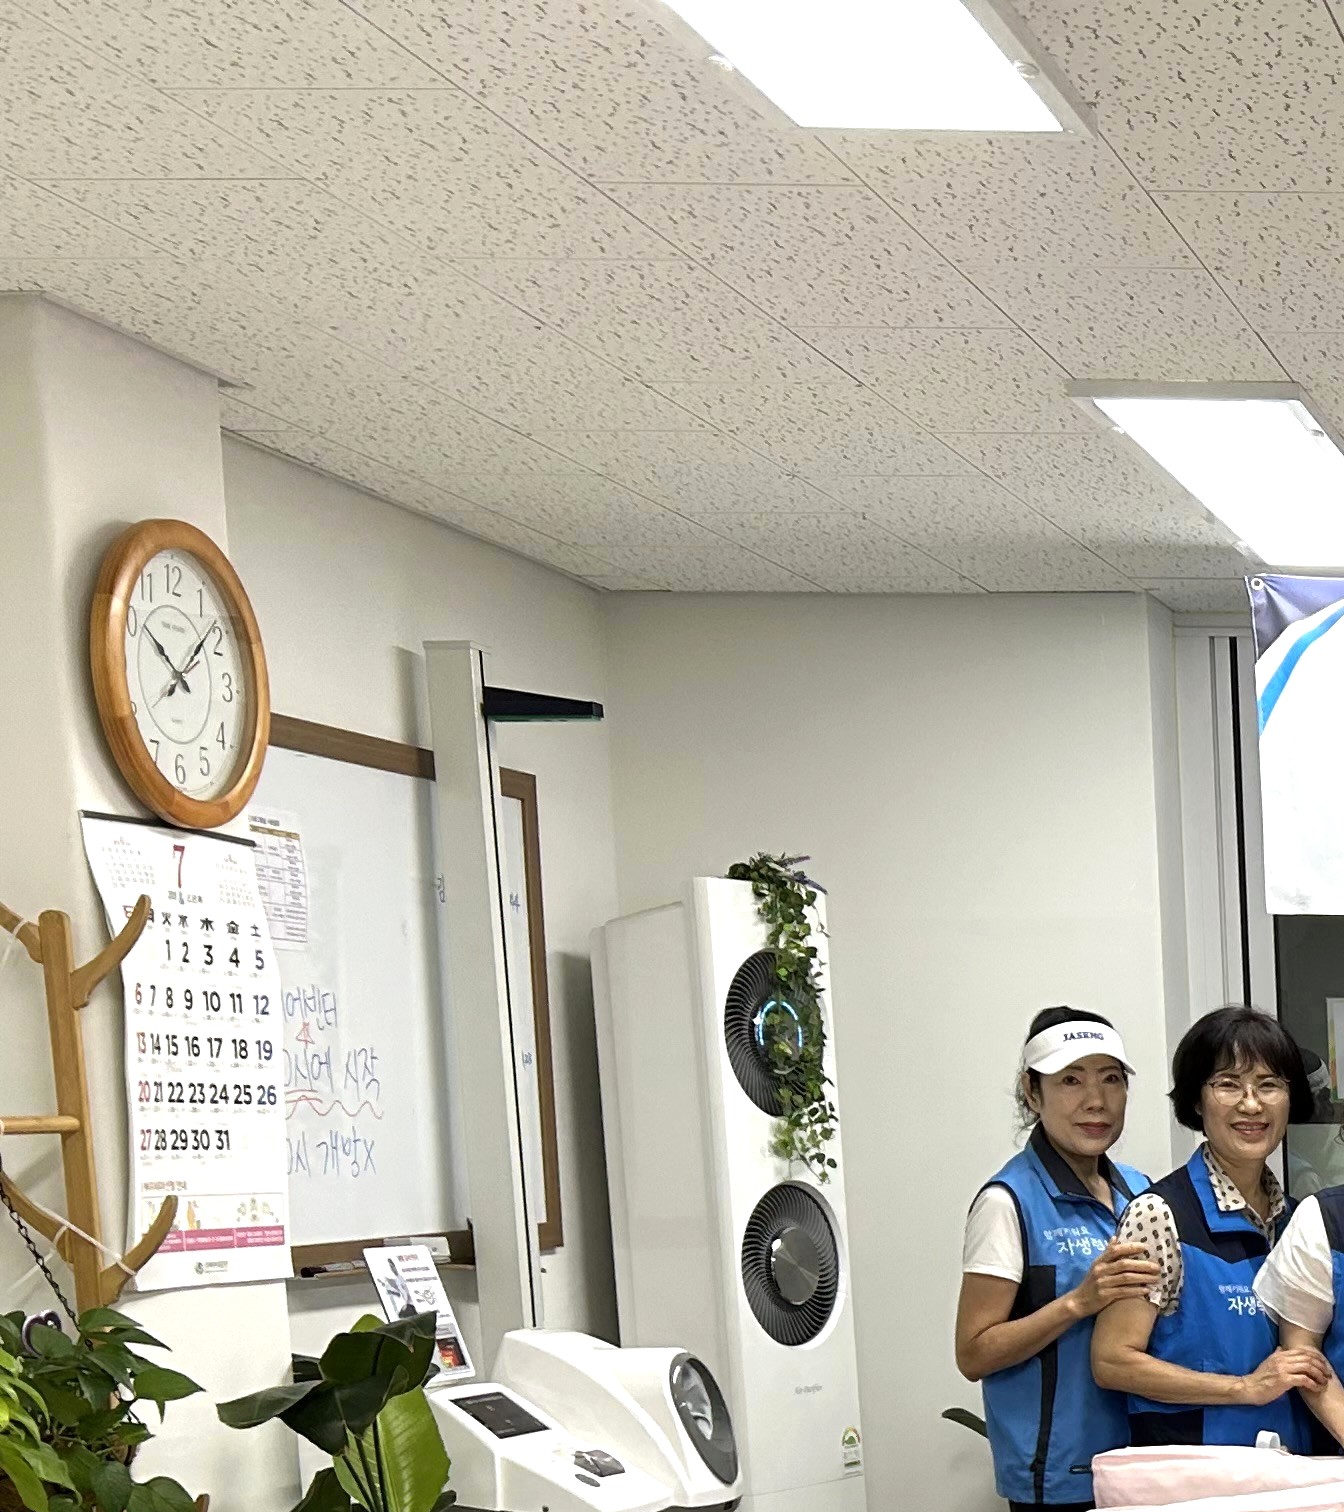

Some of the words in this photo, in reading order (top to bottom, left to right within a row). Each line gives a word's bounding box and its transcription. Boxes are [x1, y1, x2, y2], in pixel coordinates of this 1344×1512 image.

[164, 564, 182, 597] 12
[197, 588, 203, 618] 1
[212, 625, 223, 657] 2
[222, 672, 233, 703] 3
[175, 753, 186, 785] 6
[199, 746, 211, 777] 5
[216, 721, 226, 750] 4
[173, 844, 185, 889] 7
[165, 940, 171, 961] 1
[182, 942, 190, 963] 2
[203, 944, 214, 965] 3
[229, 947, 240, 968] 4
[255, 950, 264, 970] 5
[135, 982, 142, 1005] 6
[150, 985, 156, 1006] 7
[166, 987, 173, 1008] 8
[184, 989, 193, 1010] 9
[202, 990, 221, 1012] 10
[229, 992, 243, 1014] 11
[253, 995, 270, 1015] 12
[136, 1032, 146, 1054] 13
[150, 1033, 161, 1055] 14
[165, 1034, 179, 1056] 15
[185, 1036, 200, 1057] 16
[207, 1037, 223, 1058] 17
[231, 1039, 248, 1059] 18
[255, 1040, 273, 1061] 19
[138, 1080, 150, 1102] 20
[154, 1081, 163, 1102] 21
[168, 1082, 185, 1103] 22
[188, 1083, 206, 1104] 23
[209, 1083, 229, 1104] 24
[233, 1084, 252, 1105] 25
[257, 1085, 277, 1105] 26
[140, 1129, 152, 1151] 27
[154, 1129, 167, 1151] 28
[170, 1129, 188, 1150] 29
[191, 1129, 210, 1150] 30
[215, 1129, 230, 1150] 31
